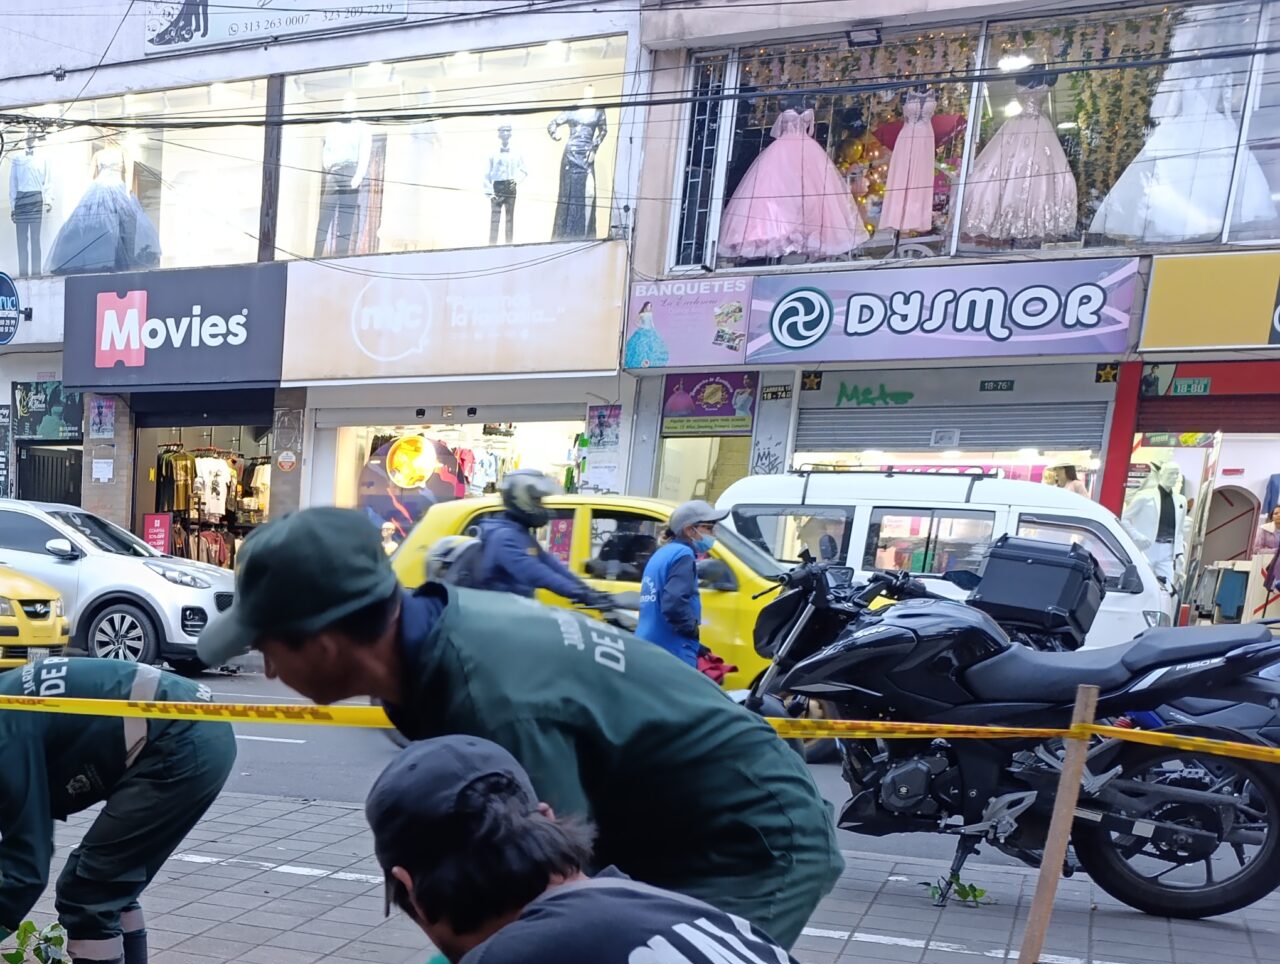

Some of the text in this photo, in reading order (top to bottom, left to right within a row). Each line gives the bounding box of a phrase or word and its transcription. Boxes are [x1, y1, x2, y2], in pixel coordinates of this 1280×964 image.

[244, 21, 260, 31] 313
[264, 18, 282, 29] 263
[285, 13, 311, 26] 0007
[635, 279, 746, 297] BANQUETES
[100, 304, 249, 350] Movies
[844, 284, 1107, 342] DYSMOR
[1176, 383, 1205, 393] 18-80
[591, 630, 626, 673] DE
[39, 665, 67, 697] DE
